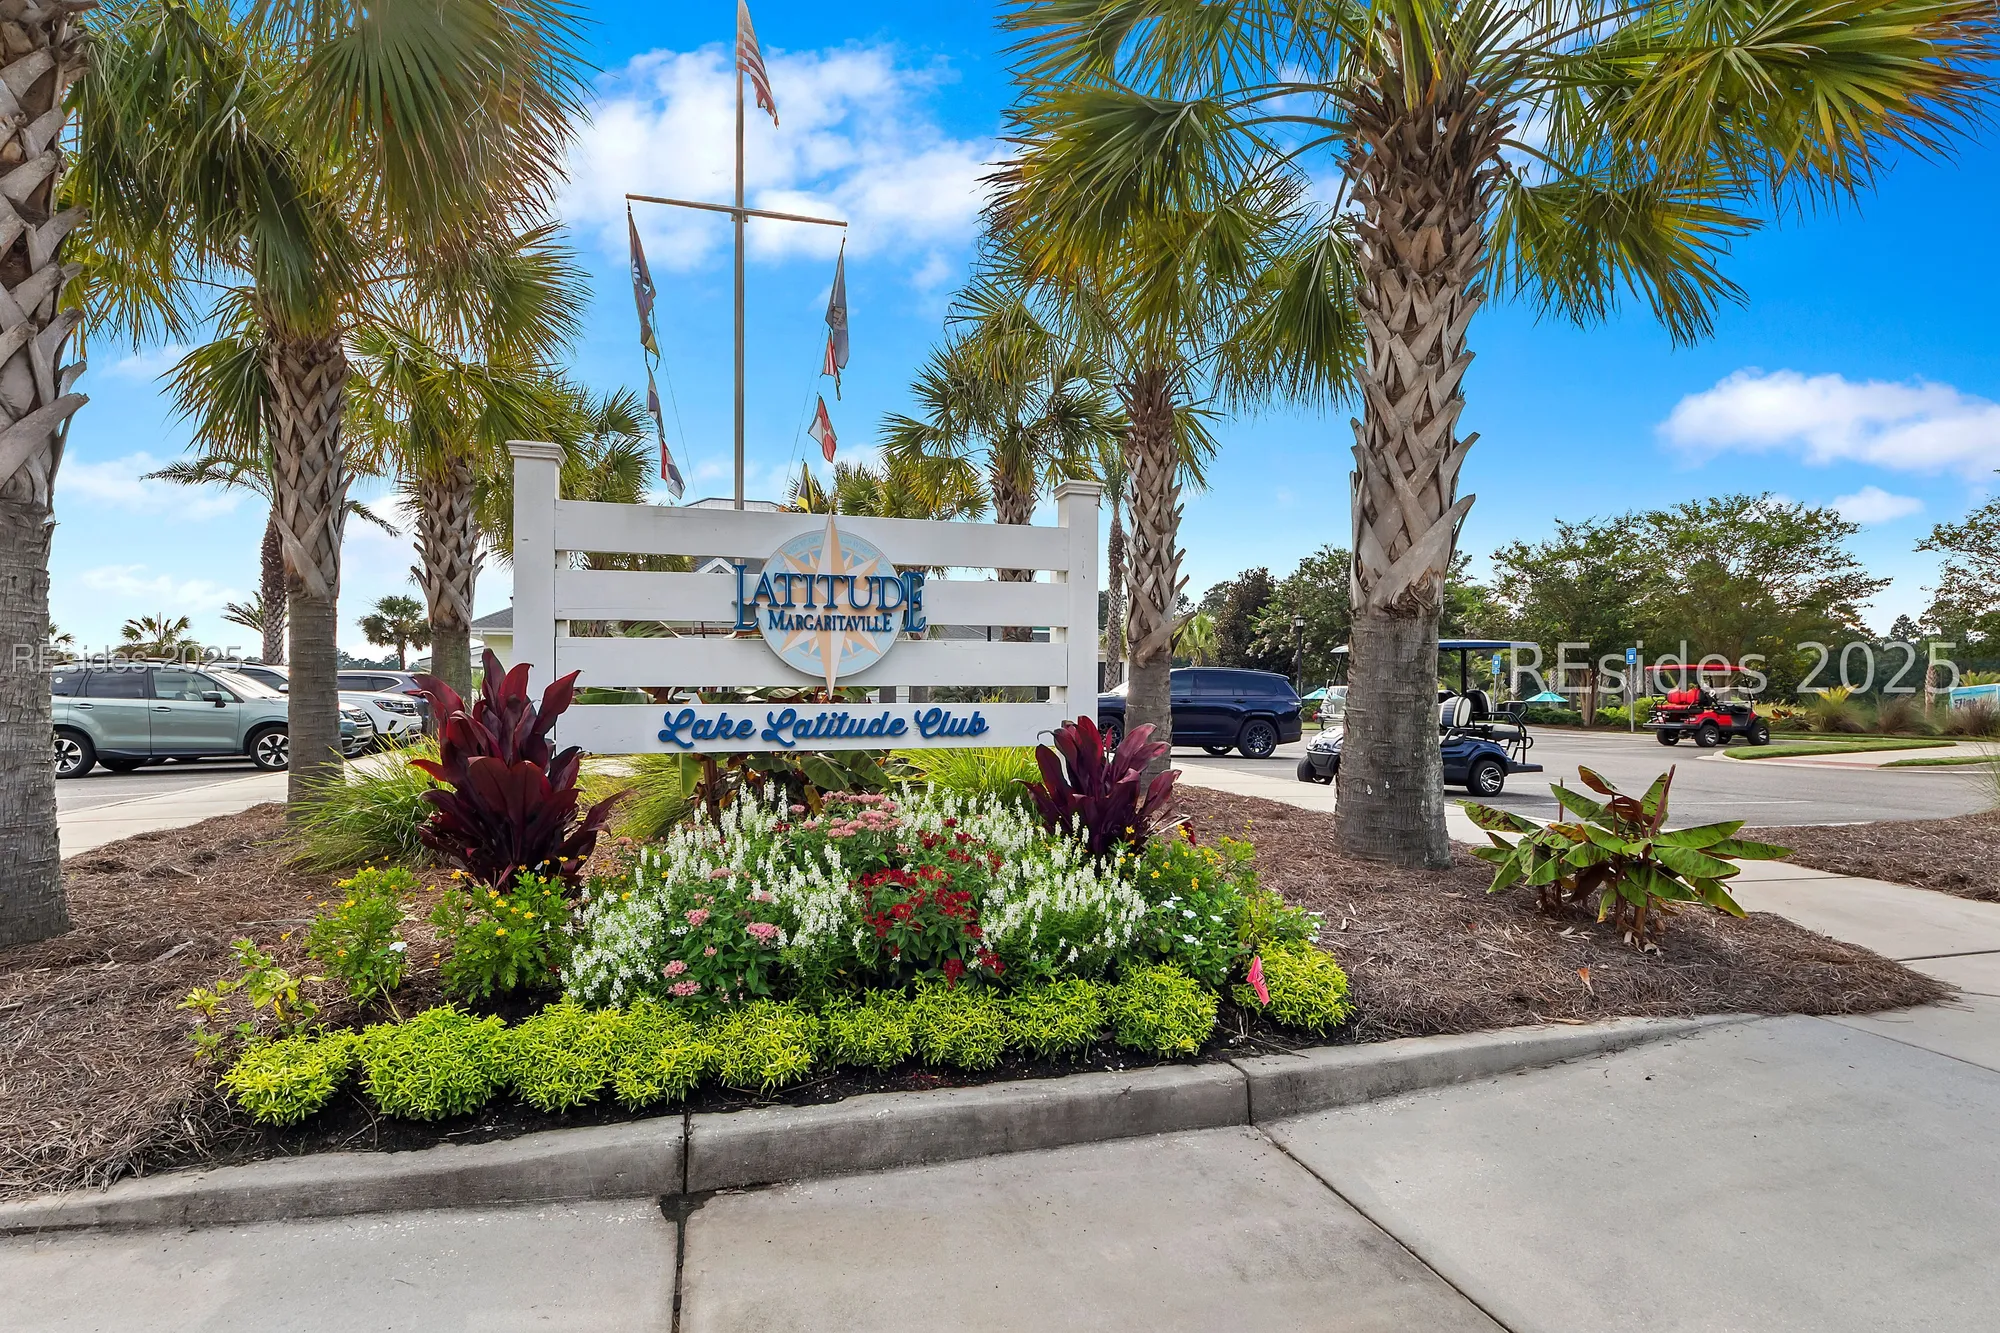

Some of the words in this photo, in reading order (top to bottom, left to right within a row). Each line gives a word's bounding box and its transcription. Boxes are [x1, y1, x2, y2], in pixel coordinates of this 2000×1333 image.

[732, 564, 926, 633] LATITUDE
[768, 609, 893, 632] MARGARITAVILLE
[658, 708, 756, 749] Lake
[761, 707, 909, 748] Latitude
[914, 707, 990, 739] Club
